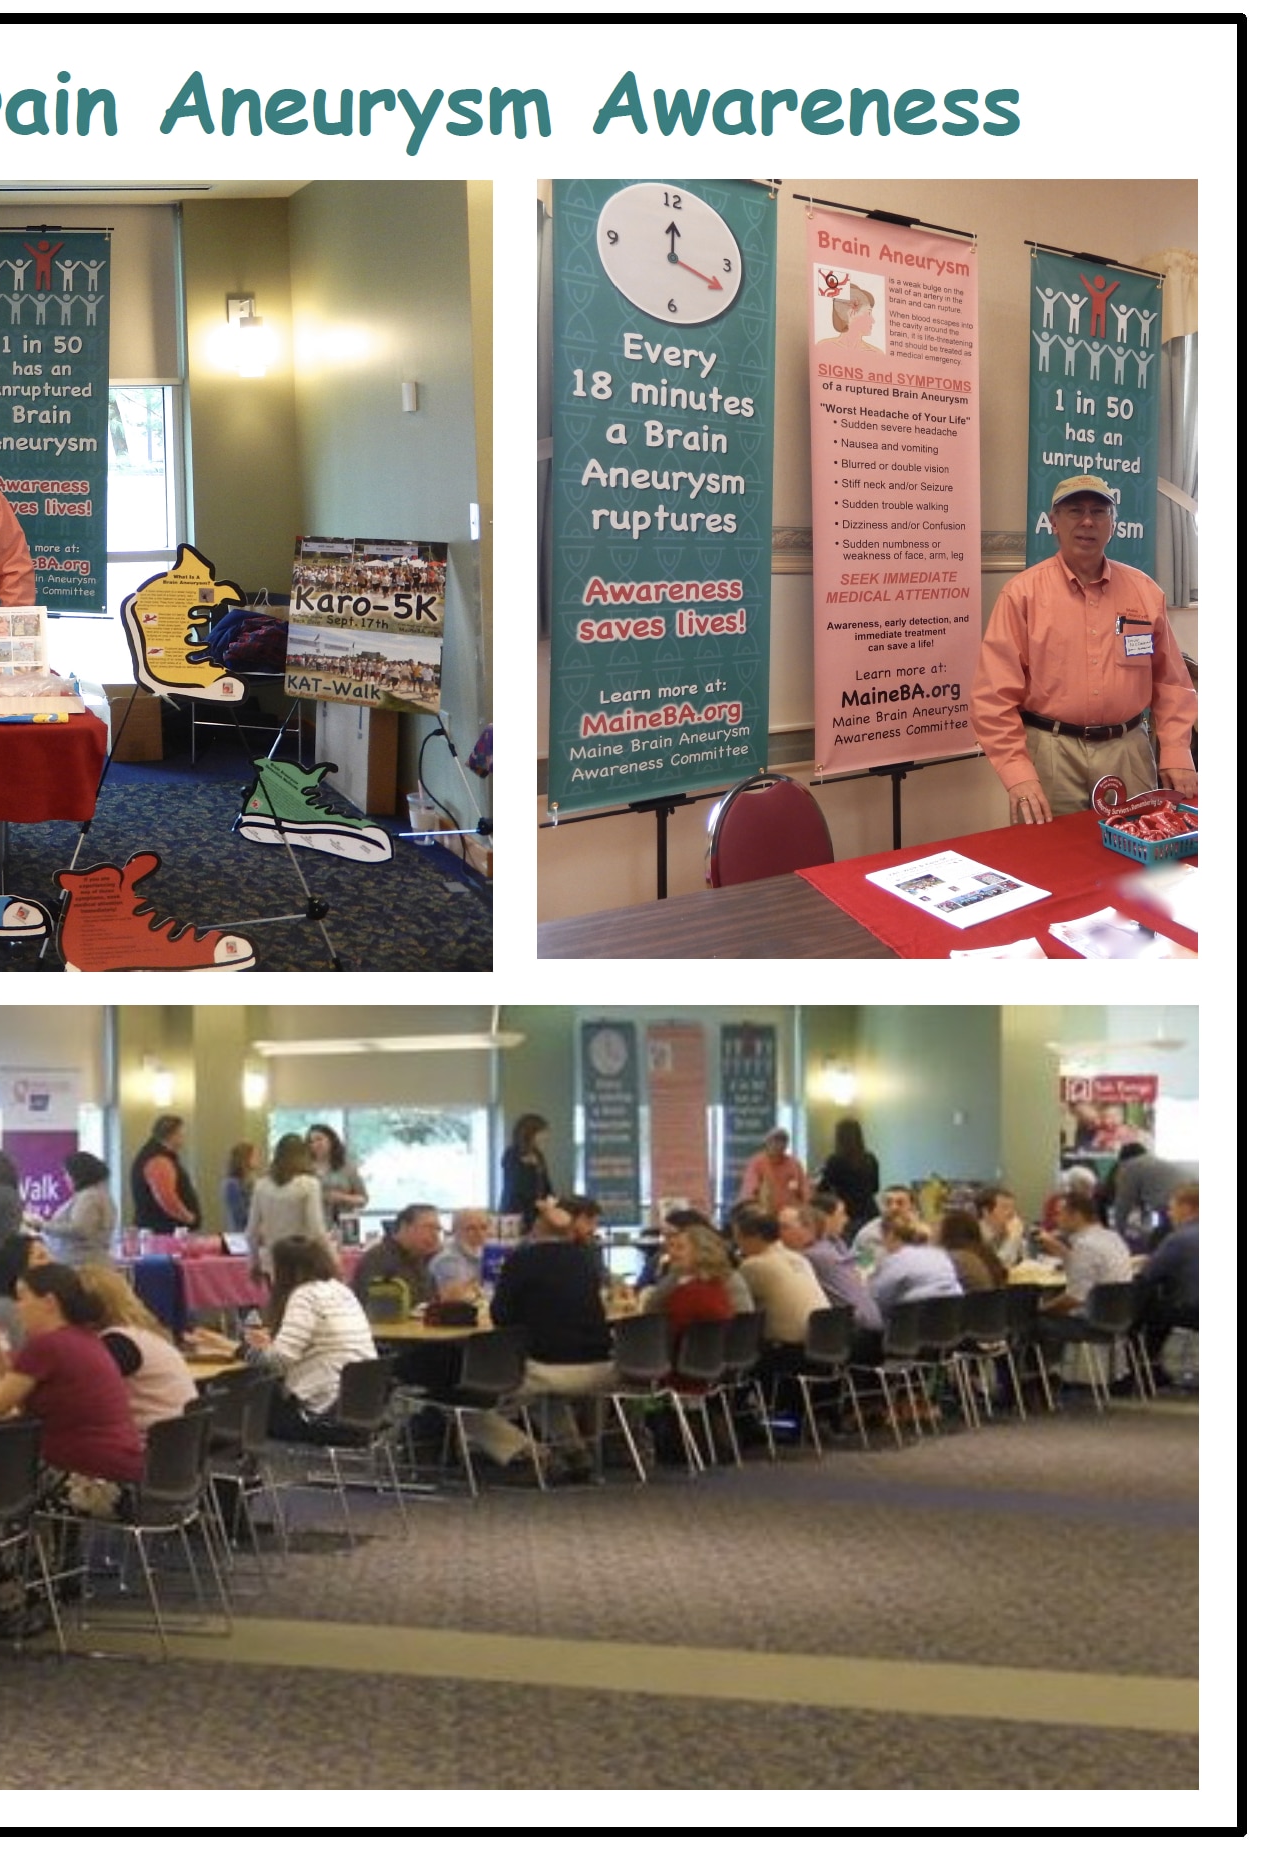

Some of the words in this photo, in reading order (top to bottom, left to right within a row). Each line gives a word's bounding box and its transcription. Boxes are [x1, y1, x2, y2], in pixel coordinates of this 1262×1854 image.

[817, 230, 871, 258] Brain
[879, 246, 970, 277] Aneurysm
[623, 332, 717, 378] Every
[572, 368, 613, 400] 18
[631, 378, 754, 417] minutes
[1056, 389, 1064, 412] 1
[1076, 390, 1095, 415] in
[1106, 396, 1134, 420] 50
[12, 405, 71, 425] Brain
[606, 423, 628, 445] a
[644, 420, 728, 454] Brain
[1066, 422, 1095, 443] has
[1103, 430, 1122, 446] an
[1042, 450, 1141, 474] unruptured
[581, 458, 745, 499] Aneurysm
[842, 479, 861, 489] Stiff
[863, 480, 886, 490] neck
[889, 480, 917, 491] and/or
[920, 482, 953, 492] Seizure
[45, 499, 92, 516] lives!
[592, 505, 737, 539] ruptures
[583, 576, 743, 606] Awareness
[840, 573, 879, 585] SEEK
[883, 571, 958, 584] IMMEDIATE
[295, 586, 438, 622] Karo-5K
[826, 590, 891, 604] MEDICAL
[895, 587, 970, 601] ATTENTION
[327, 616, 358, 628] Sept.
[361, 618, 388, 629] 17th
[577, 615, 666, 643] saves
[675, 609, 747, 638] lives!
[288, 675, 381, 700] KAT-Walk
[841, 682, 961, 708] MaineBA.org
[580, 700, 742, 739] MaineBA.org
[570, 743, 623, 761] Maine
[631, 734, 672, 754] Brain
[679, 725, 750, 746] Aneurysm
[571, 758, 663, 781] Awareness
[670, 745, 749, 767] Committee
